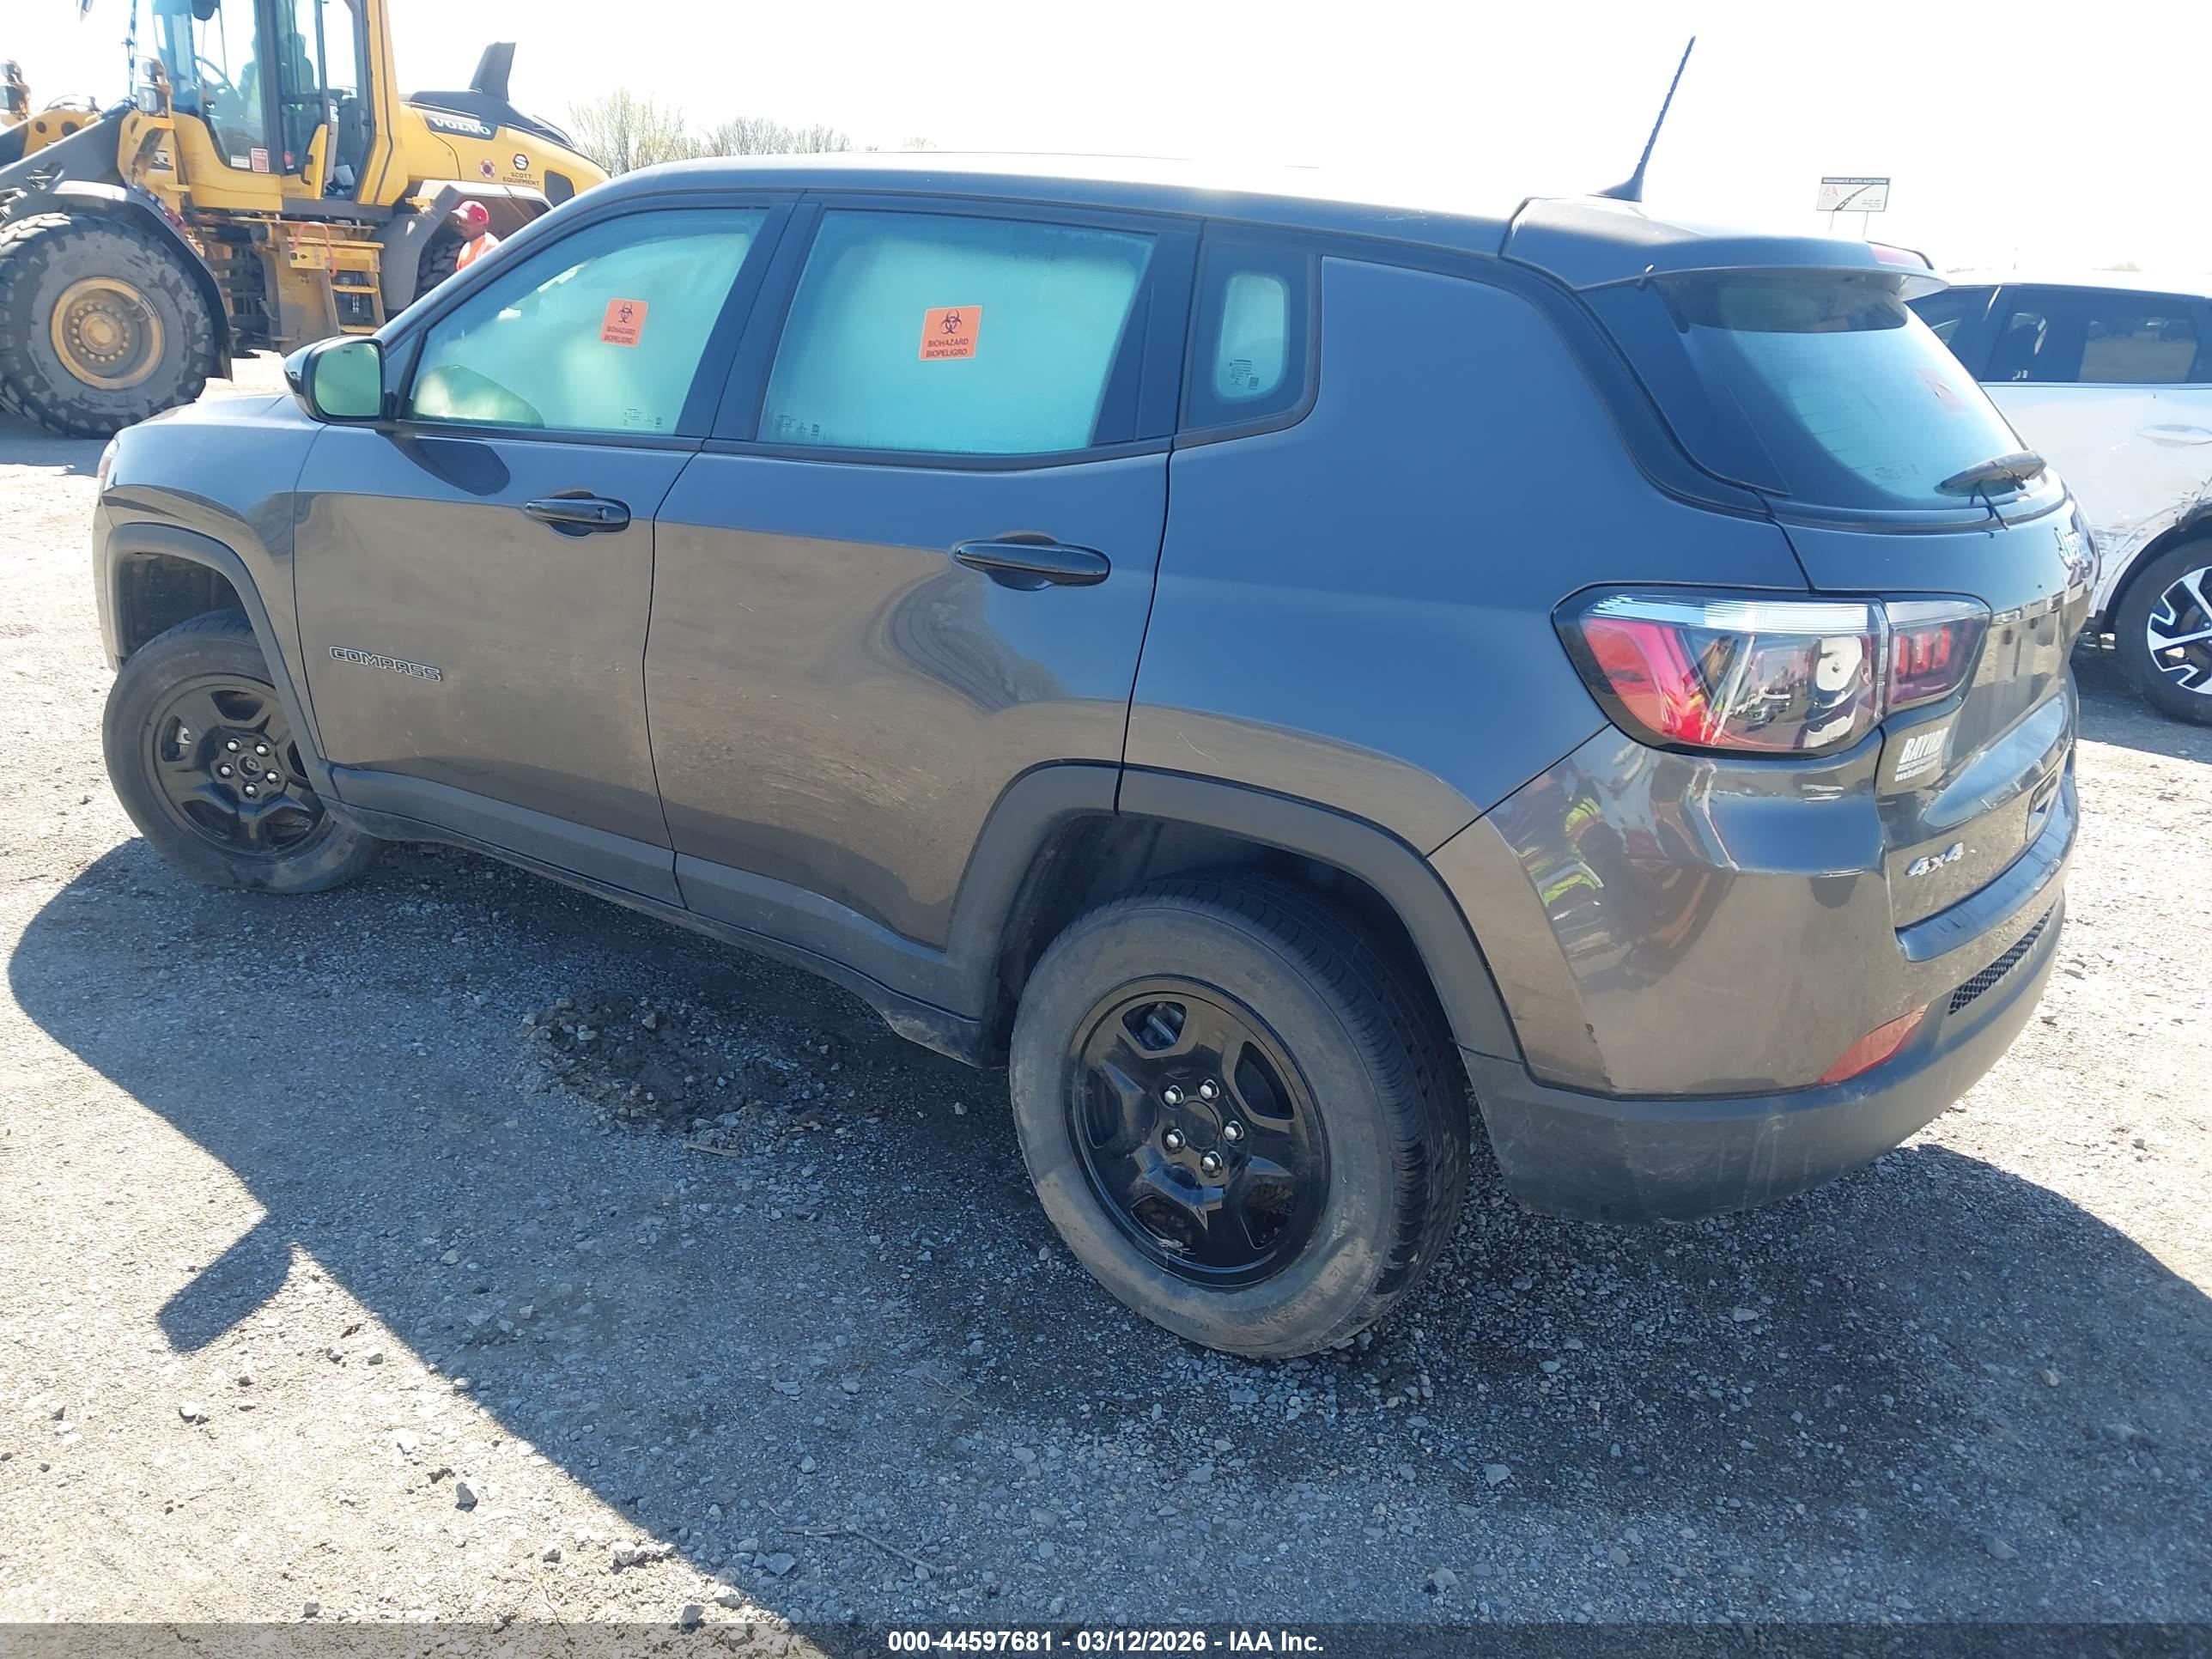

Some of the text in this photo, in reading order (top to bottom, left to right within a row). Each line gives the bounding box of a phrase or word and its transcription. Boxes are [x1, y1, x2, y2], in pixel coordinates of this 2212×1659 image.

[430, 117, 491, 136] VOLVO
[502, 177, 540, 185] EQUIPMENT
[928, 338, 969, 347] BIOHAZARD
[927, 349, 967, 357] BIOPELIGRO
[329, 646, 443, 683] COMPASS
[1905, 842, 1965, 877] 4x4
